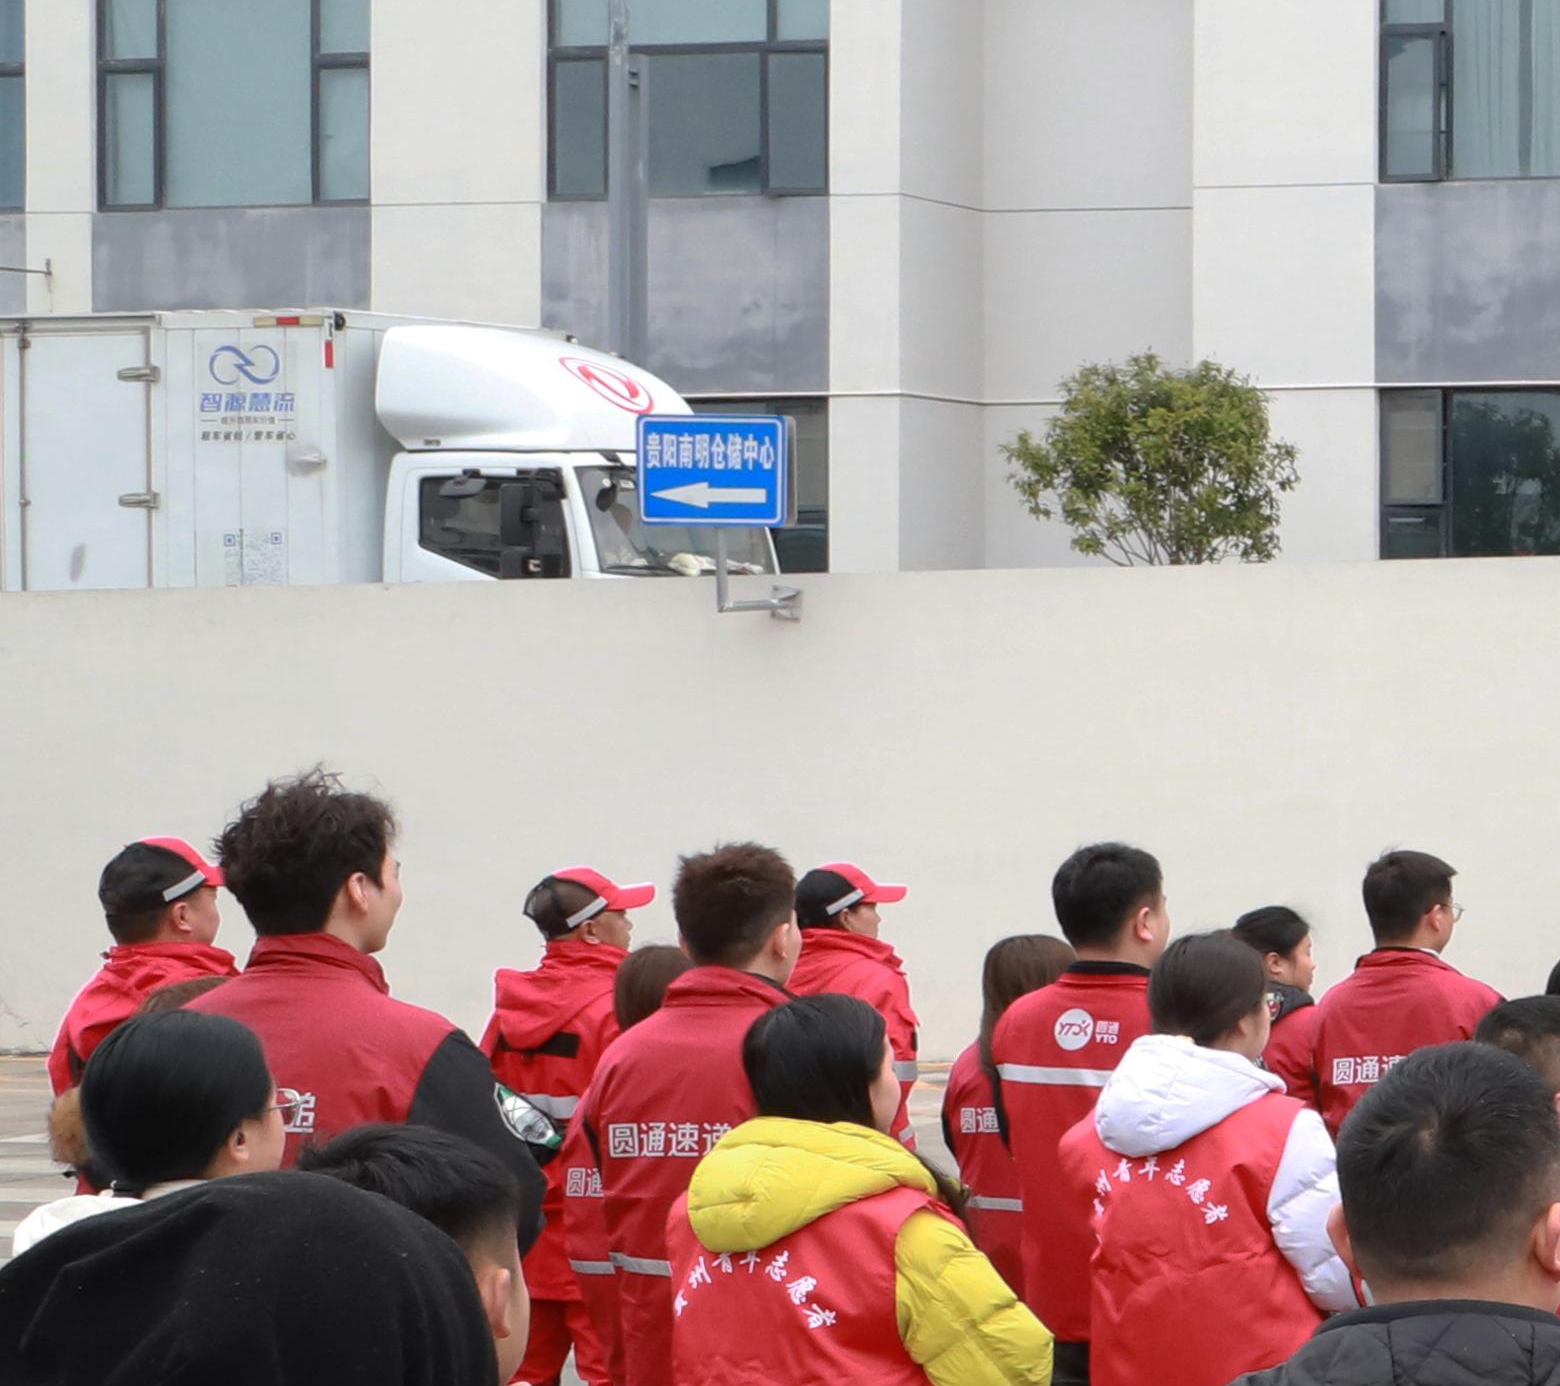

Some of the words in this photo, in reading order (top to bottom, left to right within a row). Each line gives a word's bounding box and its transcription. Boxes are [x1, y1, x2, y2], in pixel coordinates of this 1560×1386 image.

[645, 431, 776, 471] 贵阳南明仓储中心
[1096, 1034, 1118, 1044] YTO
[960, 1106, 1001, 1134] 圆通
